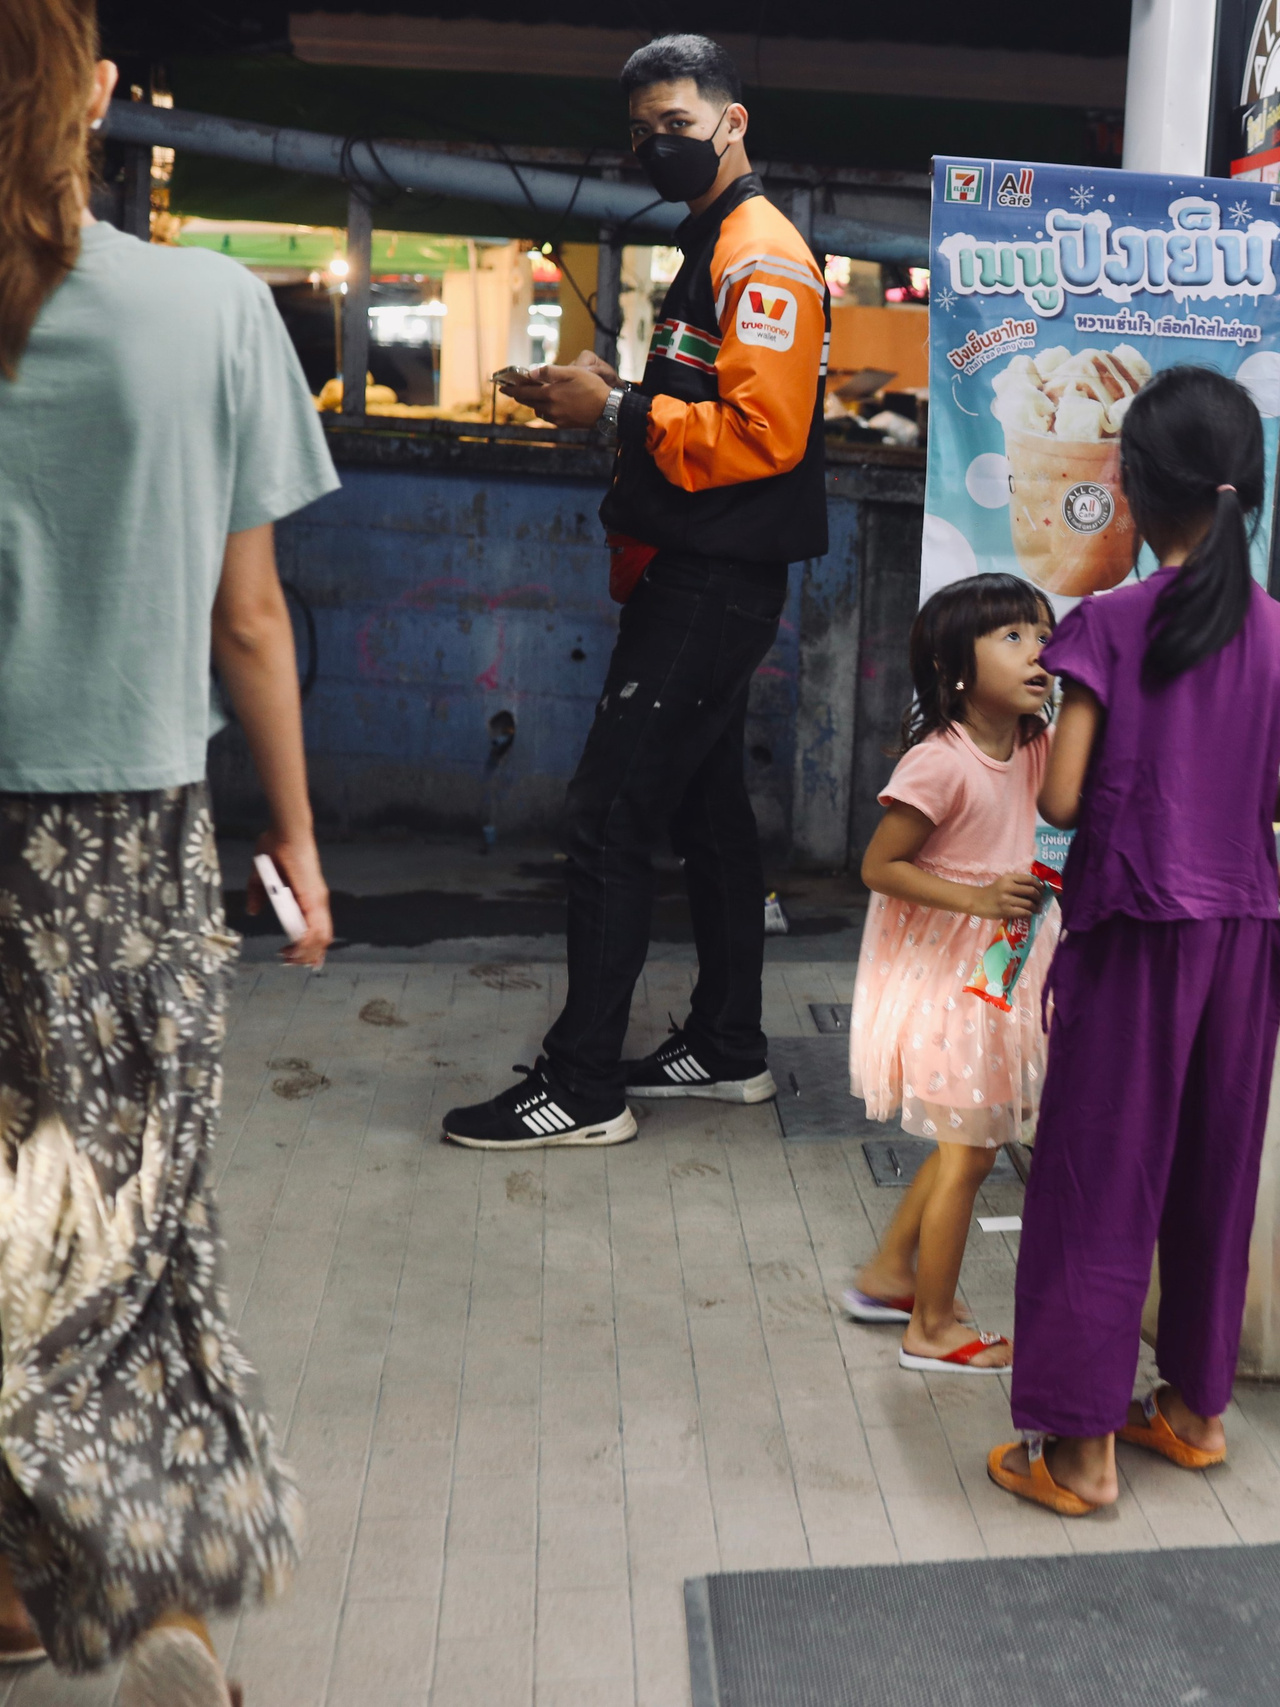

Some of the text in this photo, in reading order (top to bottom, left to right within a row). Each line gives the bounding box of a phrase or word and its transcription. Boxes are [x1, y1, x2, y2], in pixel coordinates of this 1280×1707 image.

[955, 173, 975, 200] 7
[1000, 169, 1034, 195] All
[958, 206, 1265, 312] เมนูปังเย็น
[741, 320, 790, 339] true money
[1076, 309, 1152, 334] หวานชื่นใจ
[757, 331, 777, 343] wallet
[1068, 486, 1086, 503] ALL
